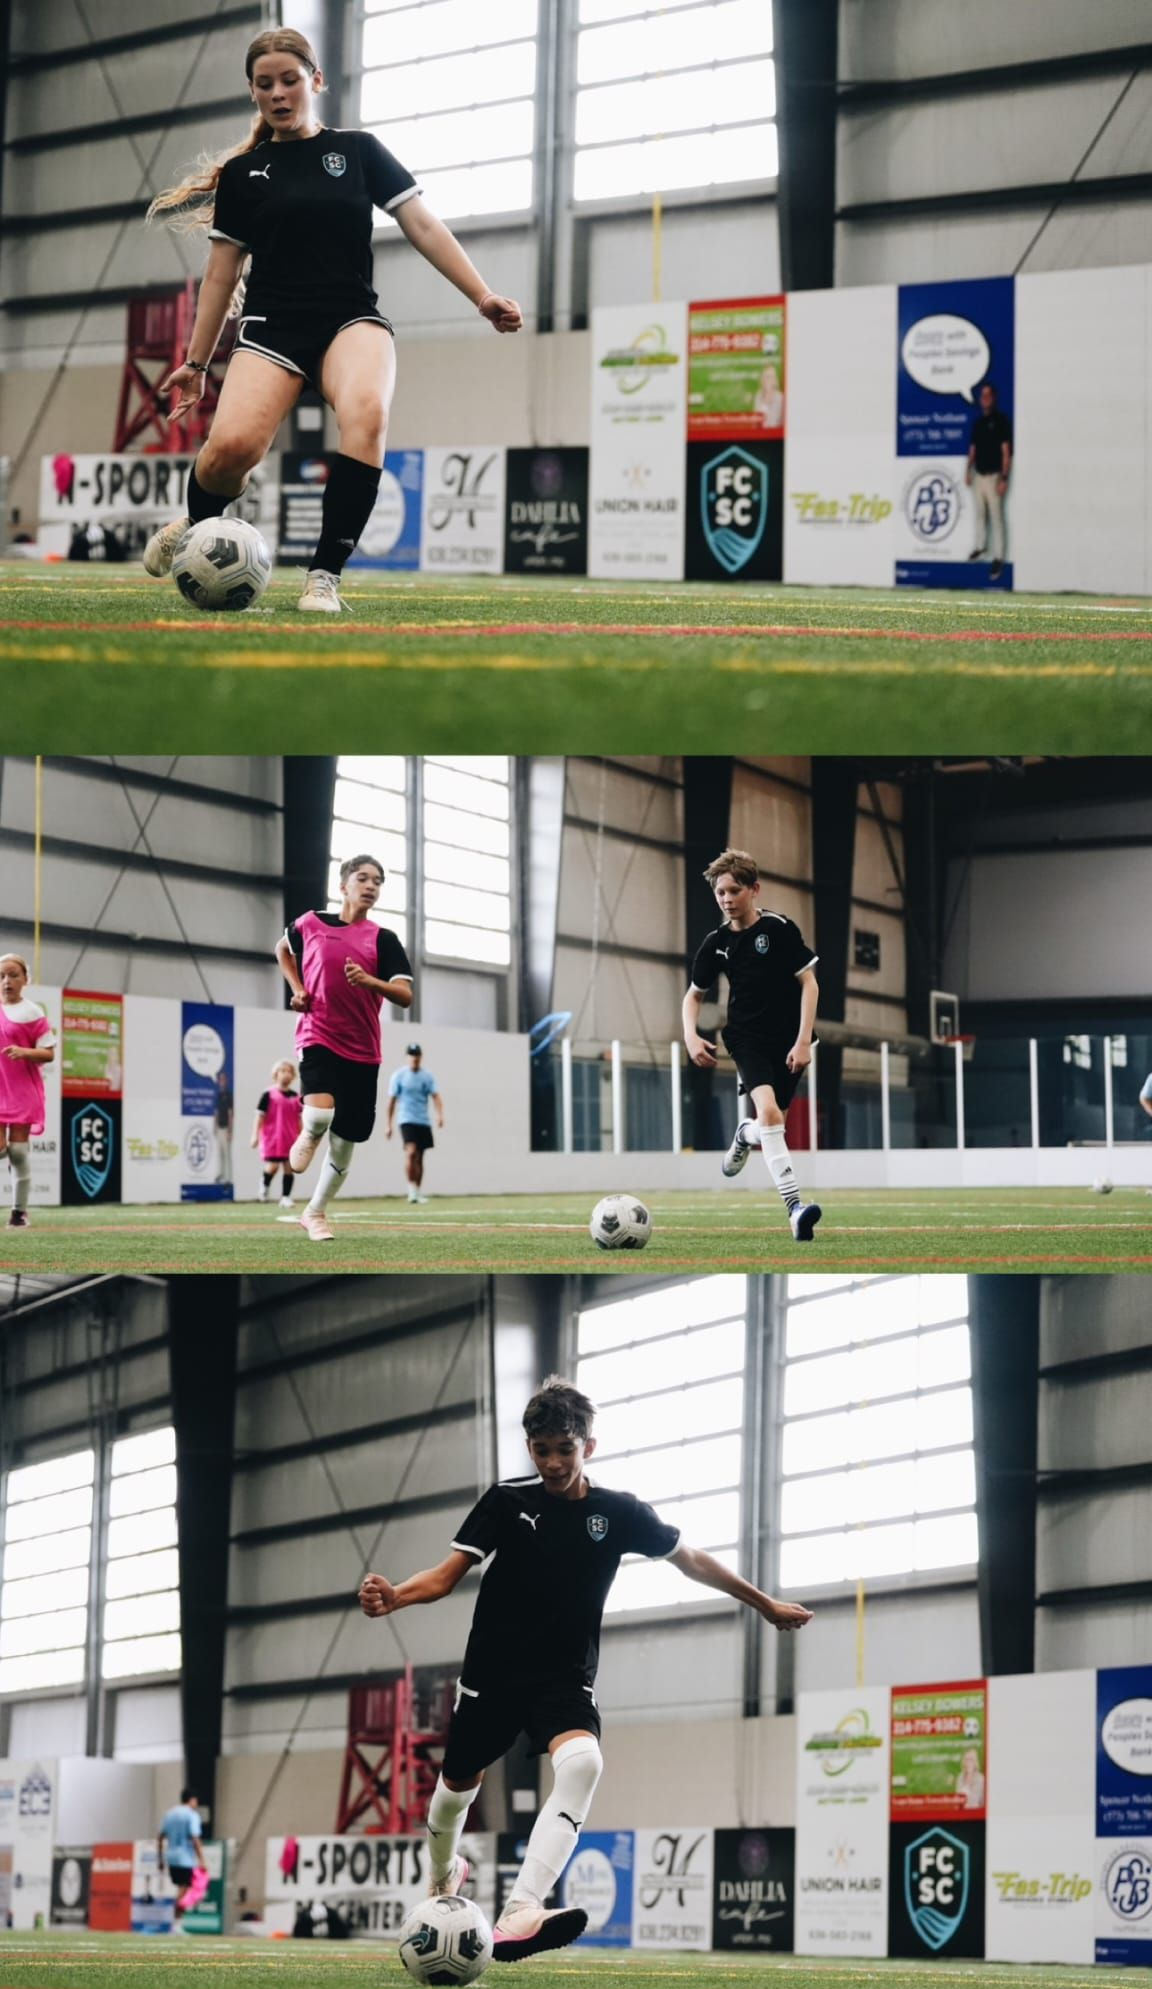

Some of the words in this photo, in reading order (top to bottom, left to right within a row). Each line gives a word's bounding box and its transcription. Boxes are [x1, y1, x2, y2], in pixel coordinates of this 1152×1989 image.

[716, 466, 752, 495] FC
[595, 498, 640, 514] UNION
[643, 497, 678, 513] HAIR
[715, 498, 752, 527] SC
[81, 1118, 103, 1139] FC
[81, 1141, 103, 1162] SC
[919, 1847, 954, 1873] FC
[719, 1880, 787, 1902] DAHLIA
[801, 1877, 846, 1893] UNION
[849, 1876, 882, 1891] HAIR
[918, 1878, 954, 1904] SC
[992, 1871, 1093, 1901] Fas-Trip
